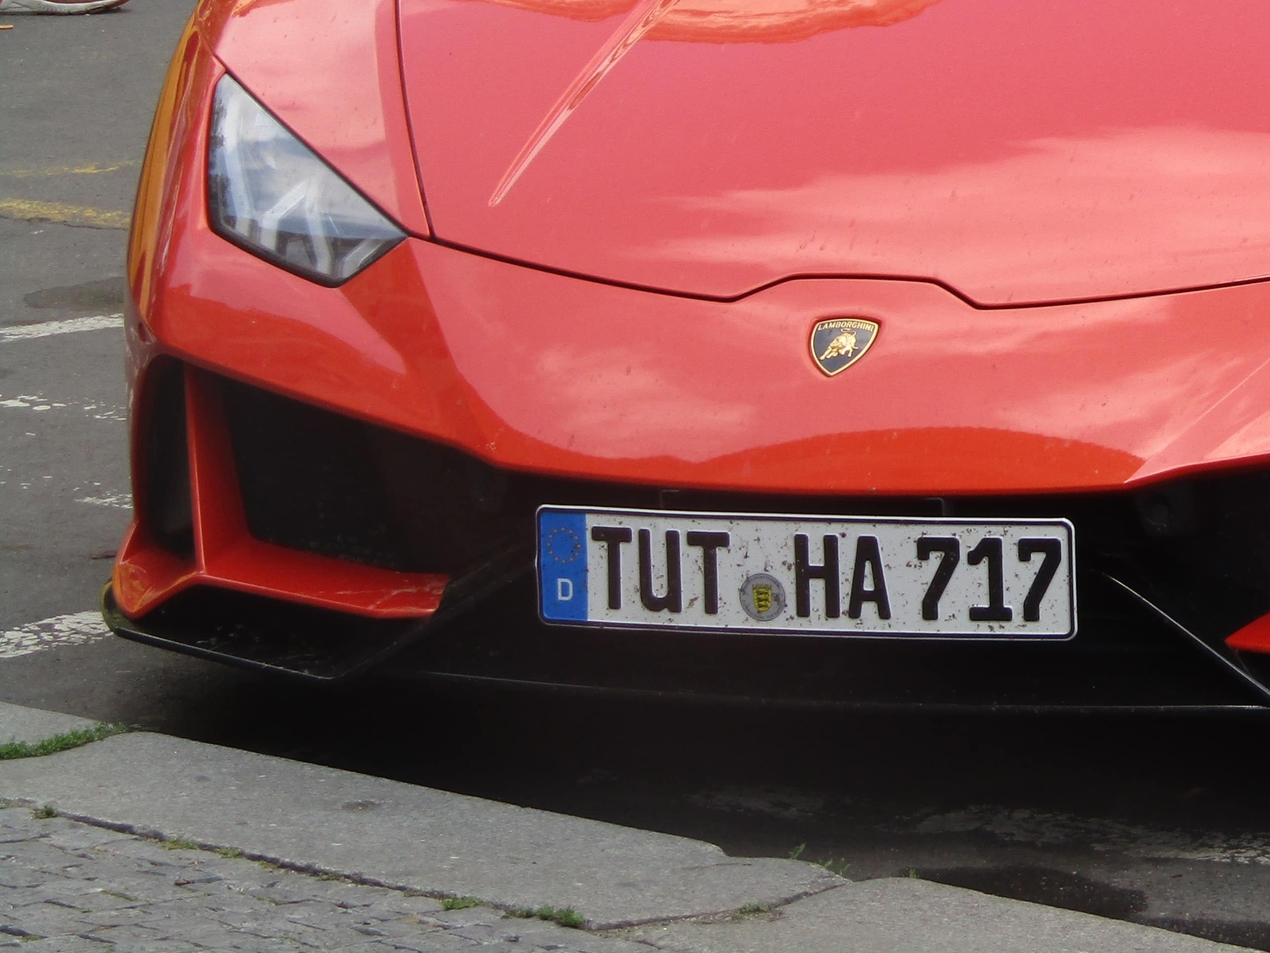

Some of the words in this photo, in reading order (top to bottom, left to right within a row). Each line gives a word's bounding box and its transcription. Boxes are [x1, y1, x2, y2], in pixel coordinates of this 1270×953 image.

[817, 321, 875, 332] LAMBORGHINI
[591, 526, 730, 615] TUT
[794, 534, 891, 621] HA
[914, 536, 1063, 623] 717
[557, 578, 573, 601] D
